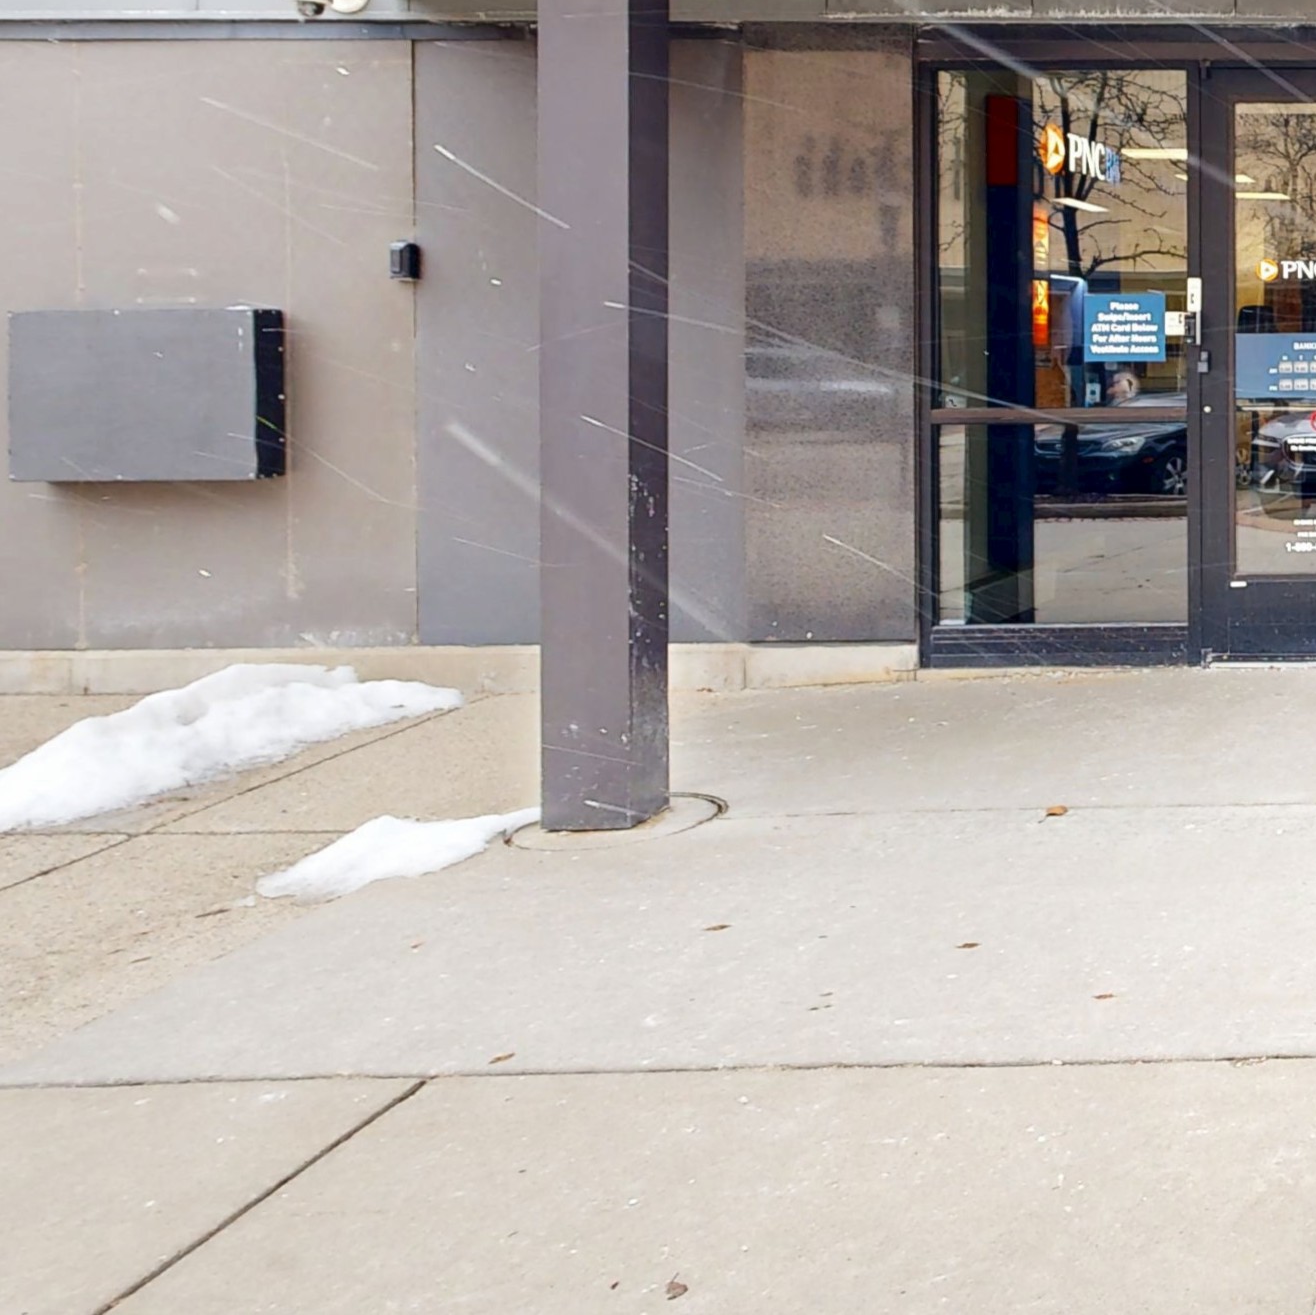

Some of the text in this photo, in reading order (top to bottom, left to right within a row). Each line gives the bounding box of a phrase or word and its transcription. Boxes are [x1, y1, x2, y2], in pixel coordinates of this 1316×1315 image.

[1066, 132, 1106, 181] PNC
[1110, 302, 1139, 310] Please
[1091, 323, 1158, 332] ATM Card Below
[1092, 334, 1157, 343] For After Hours
